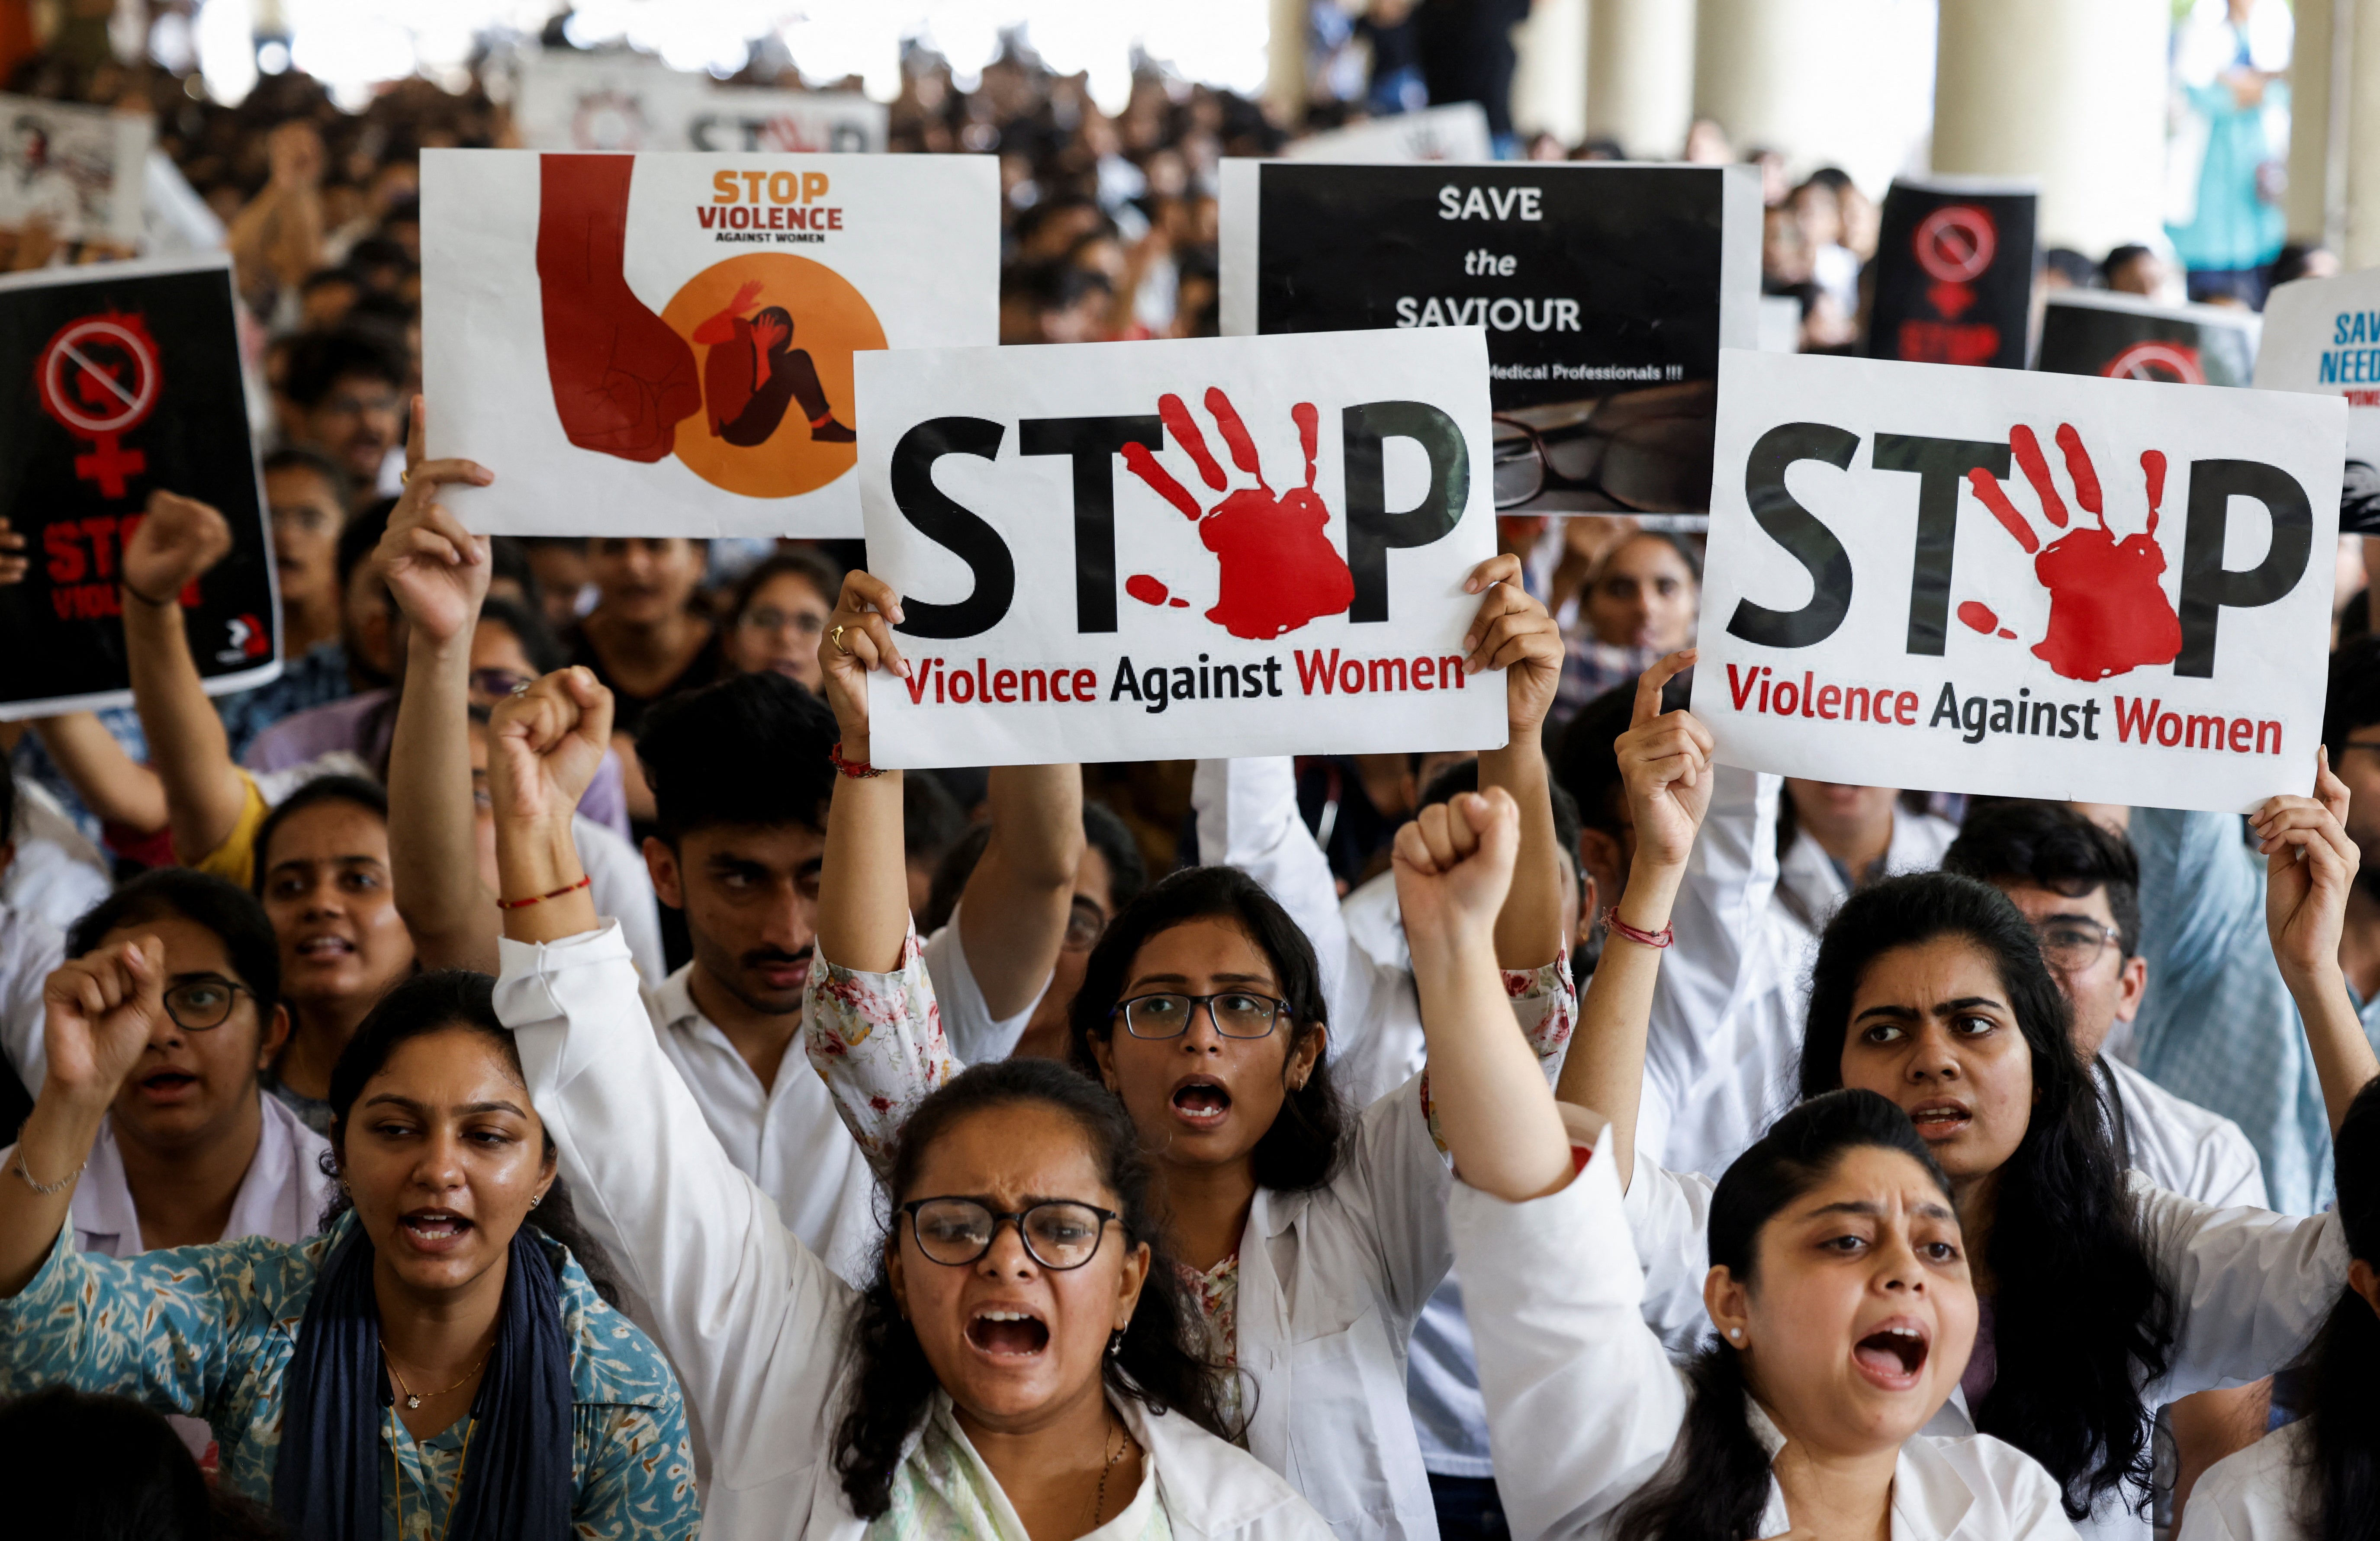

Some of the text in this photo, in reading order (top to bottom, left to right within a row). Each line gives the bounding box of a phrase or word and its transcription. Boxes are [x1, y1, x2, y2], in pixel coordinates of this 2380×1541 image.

[713, 170, 829, 205] STOP
[1438, 185, 1543, 221] SAVE
[698, 207, 843, 230] VIOLENCE
[715, 232, 825, 243] AGAINST WOMEN
[1465, 248, 1517, 276] the
[1396, 296, 1581, 332] SAVIOUR
[1552, 363, 1662, 380] Professionals
[904, 648, 1465, 714] Violence Against Women
[1727, 664, 2282, 754] Violence Against Women
